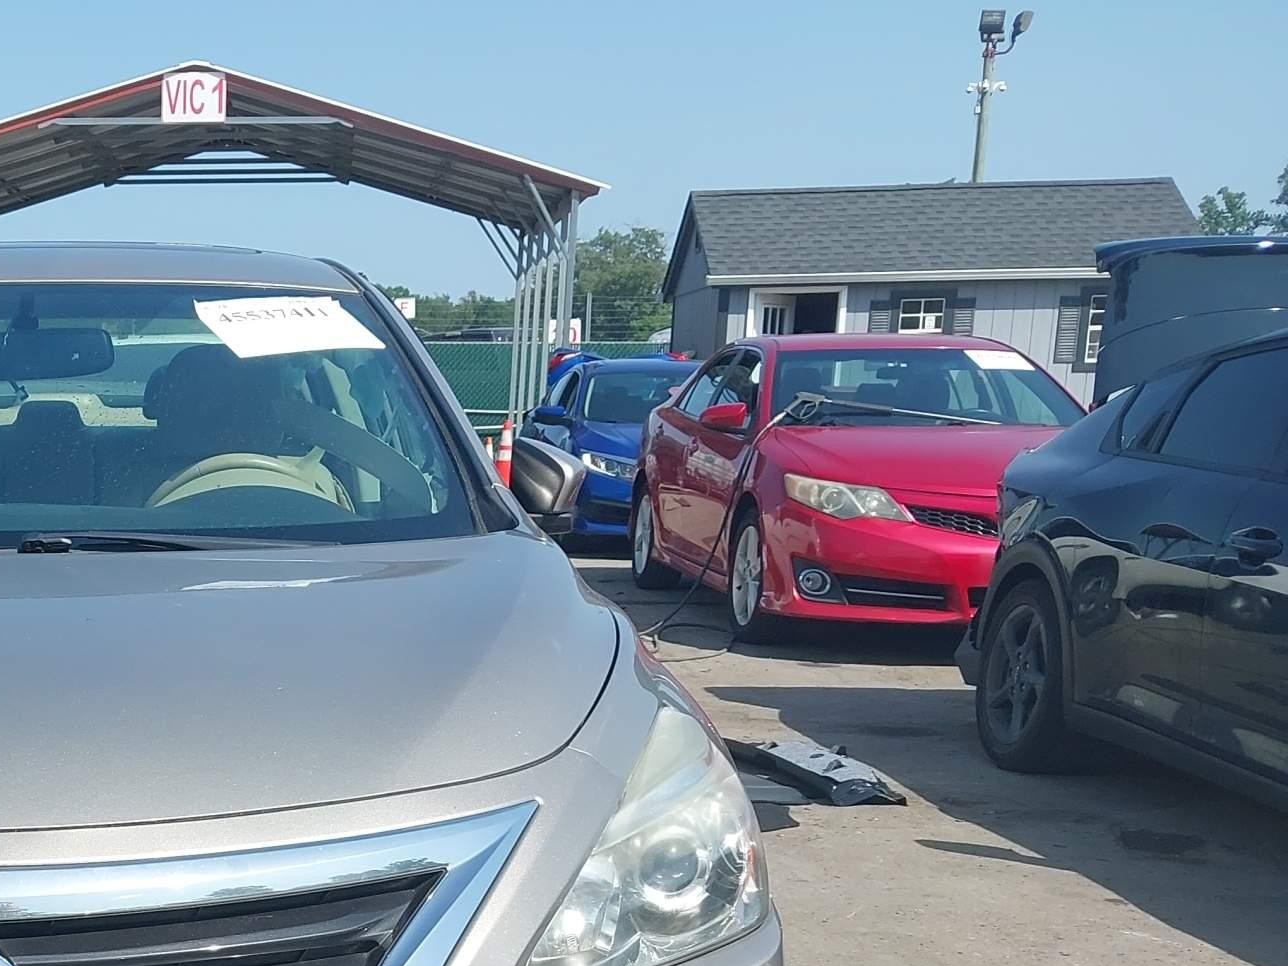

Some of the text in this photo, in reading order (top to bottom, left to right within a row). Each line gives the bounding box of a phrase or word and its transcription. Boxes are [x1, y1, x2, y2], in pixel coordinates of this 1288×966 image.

[165, 78, 224, 115] VIC 1
[219, 306, 330, 323] 45537411
